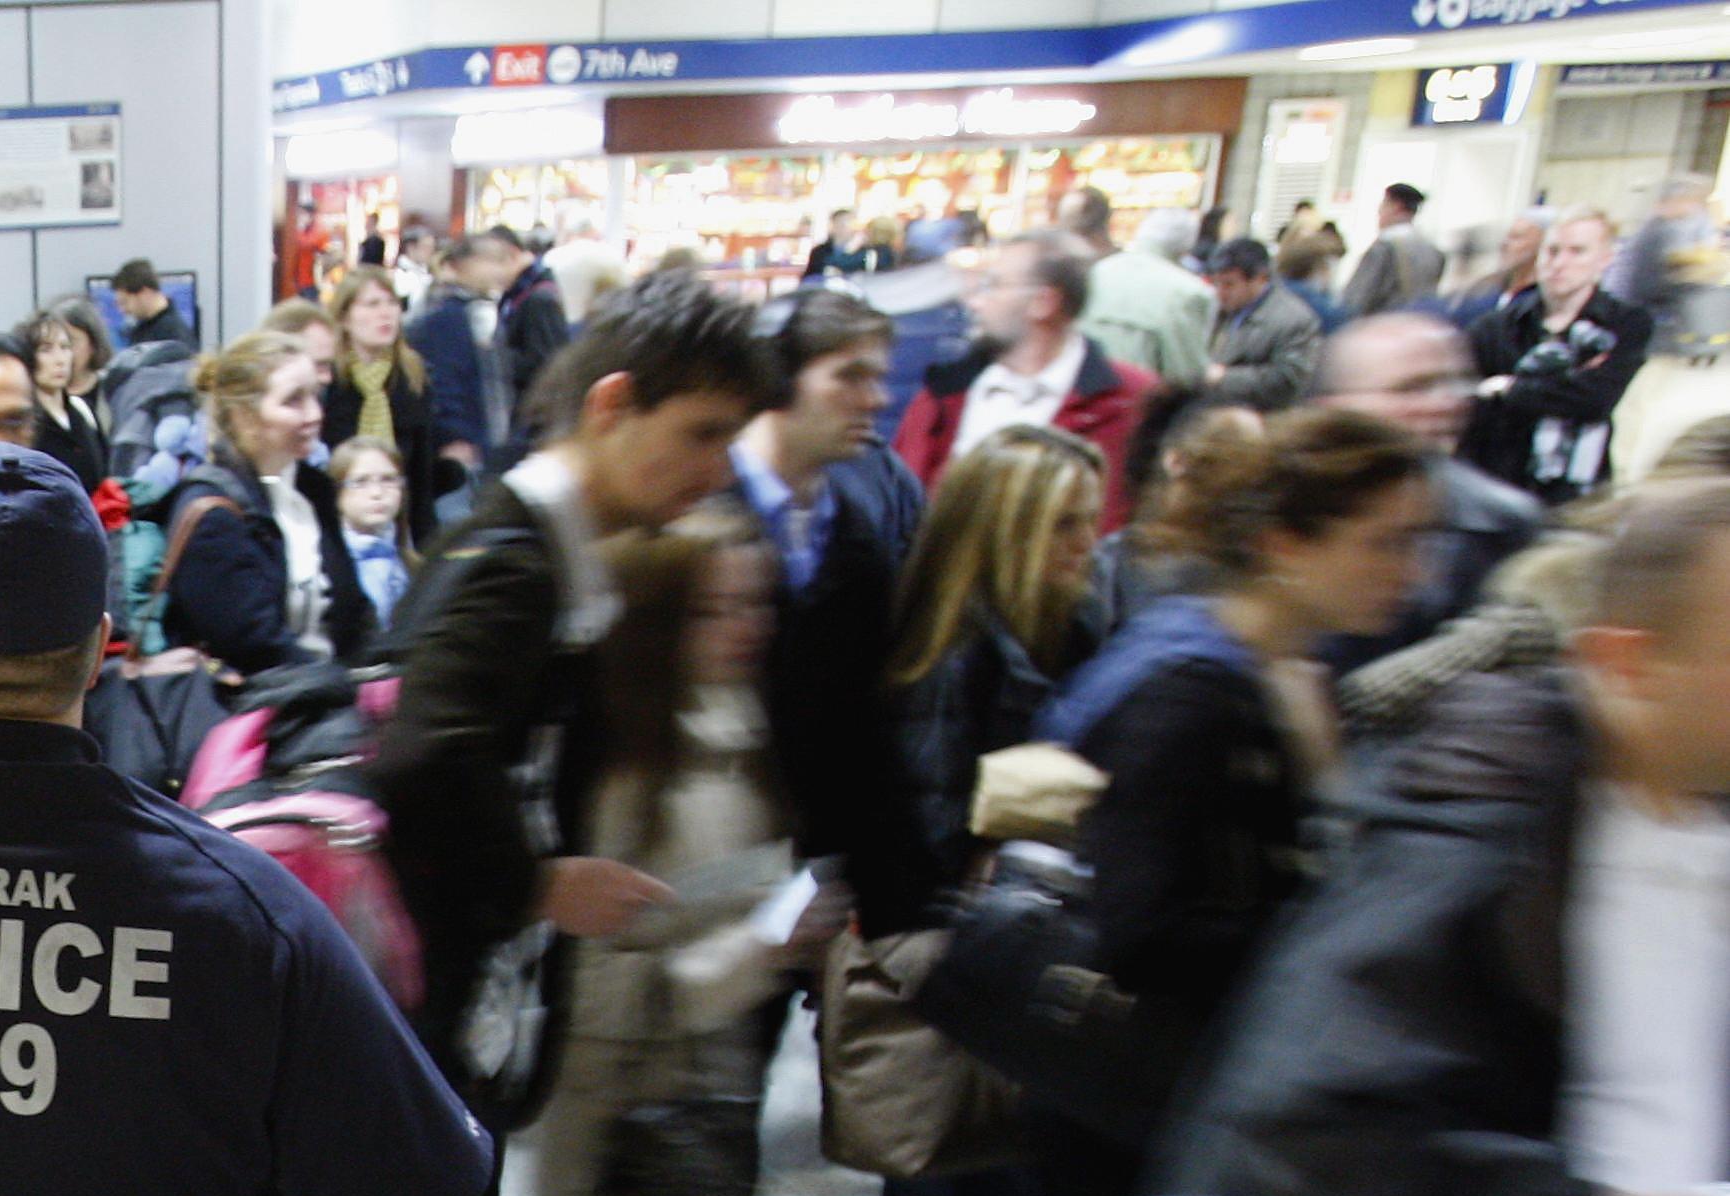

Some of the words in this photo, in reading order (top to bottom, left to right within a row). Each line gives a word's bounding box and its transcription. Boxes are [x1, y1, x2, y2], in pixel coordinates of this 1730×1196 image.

[494, 51, 542, 83] Exit
[582, 47, 627, 79] 7th
[627, 47, 679, 77] Ave
